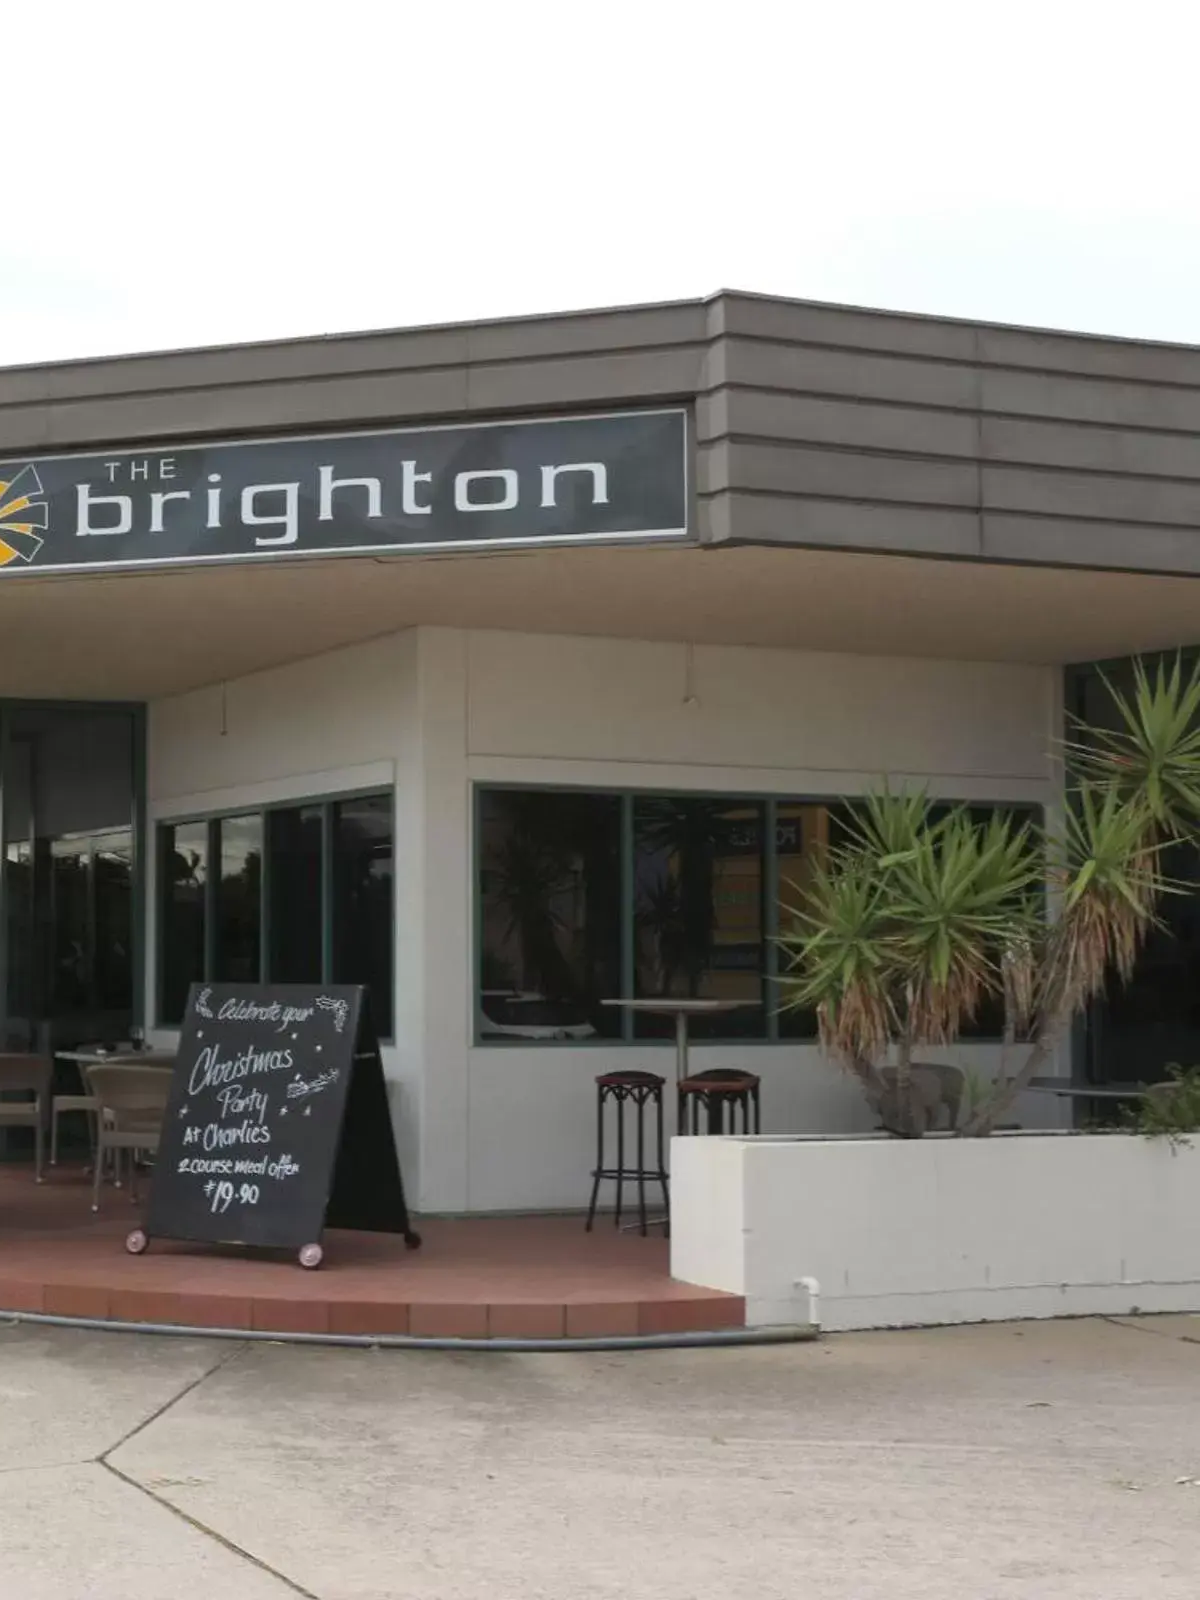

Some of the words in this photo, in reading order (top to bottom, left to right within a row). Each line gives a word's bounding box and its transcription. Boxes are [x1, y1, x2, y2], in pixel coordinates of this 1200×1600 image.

[104, 457, 178, 483] THE
[76, 459, 610, 546] brighton
[217, 997, 279, 1022] Celebrate
[274, 1006, 315, 1033] your
[188, 1043, 294, 1096] Christmas
[216, 1084, 269, 1124] Party
[183, 1126, 202, 1146] At
[202, 1120, 272, 1152] Charlies
[188, 1158, 234, 1175] course
[234, 1155, 267, 1175] meal
[268, 1154, 300, 1181] offer
[203, 1178, 260, 1214] $19.90
